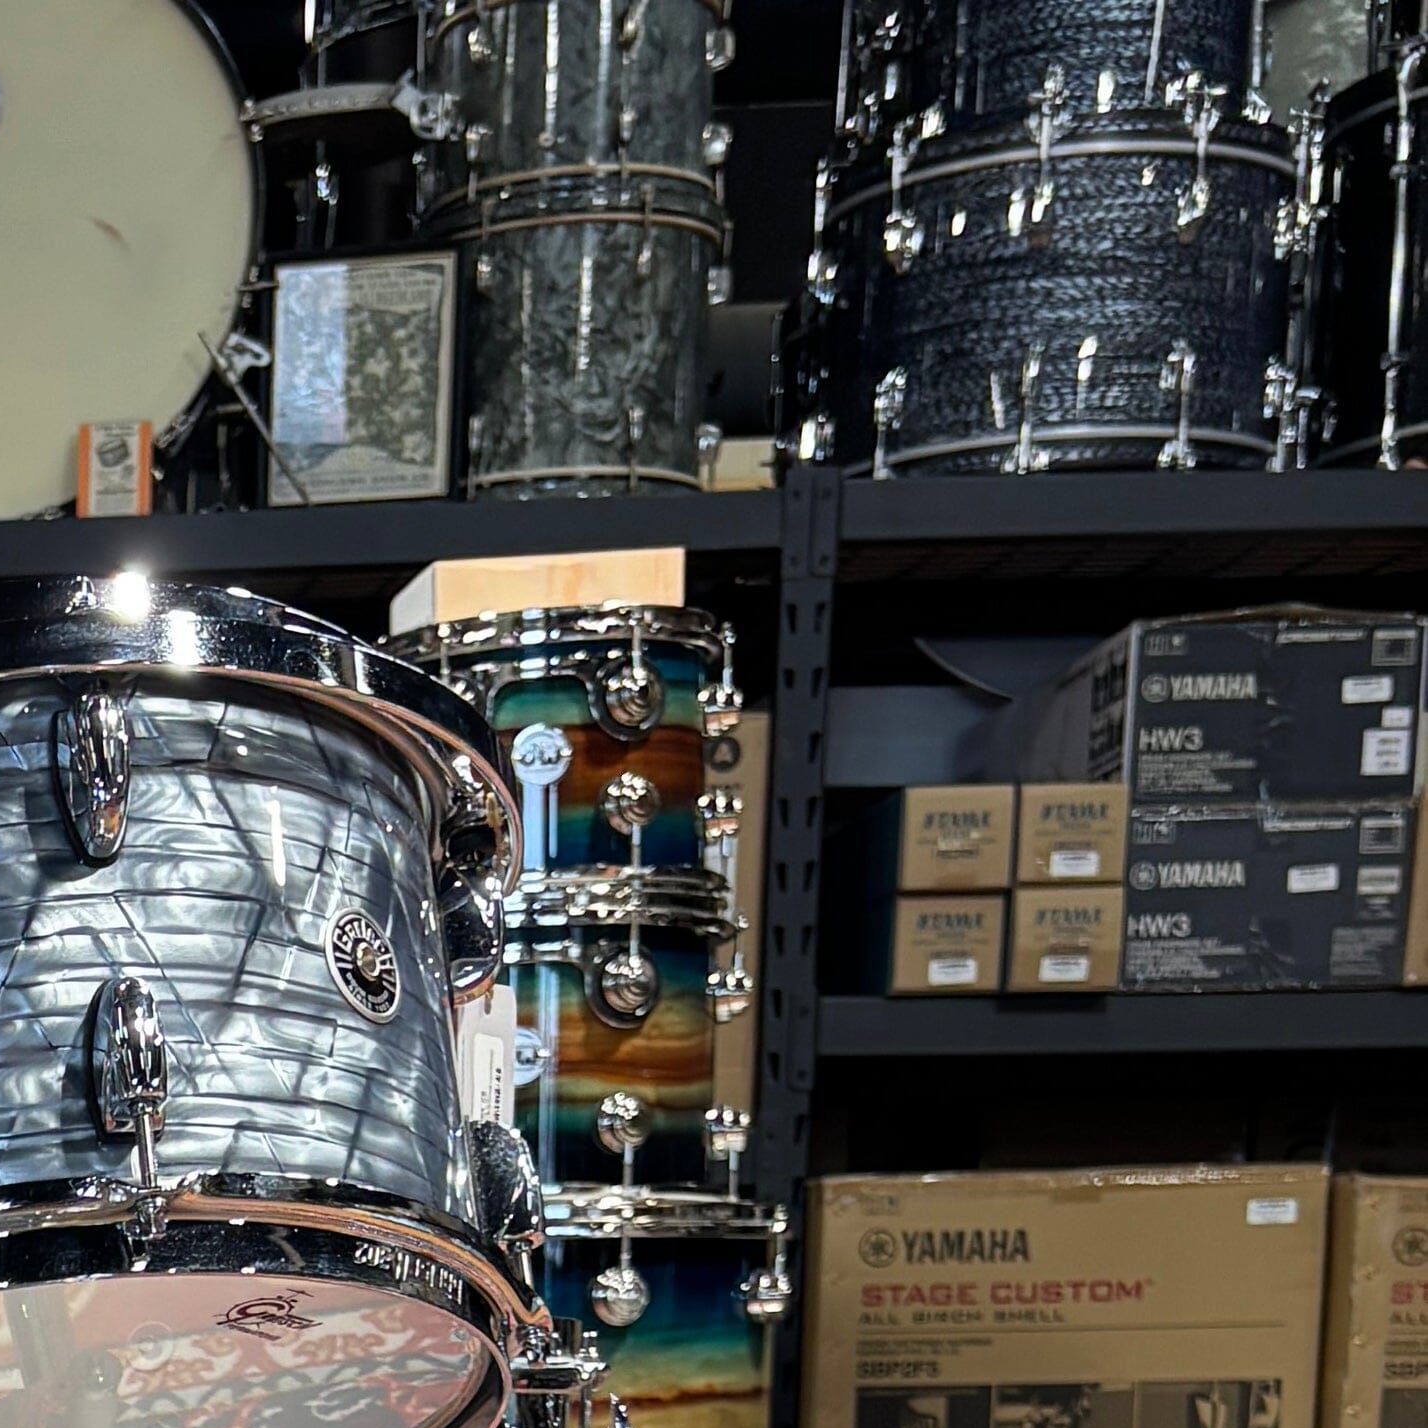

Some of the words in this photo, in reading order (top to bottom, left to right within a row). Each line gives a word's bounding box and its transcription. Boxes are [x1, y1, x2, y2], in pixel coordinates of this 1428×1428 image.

[1171, 675, 1258, 700] YAMAHA
[1138, 726, 1203, 751] HW3
[1157, 860, 1246, 889] YAMAHA
[1127, 911, 1192, 938] HW3
[901, 1228, 1032, 1264] YAMAHA
[860, 1282, 979, 1307] STAGE
[989, 1279, 1145, 1305] CUSTOM
[858, 1311, 899, 1325] ALL
